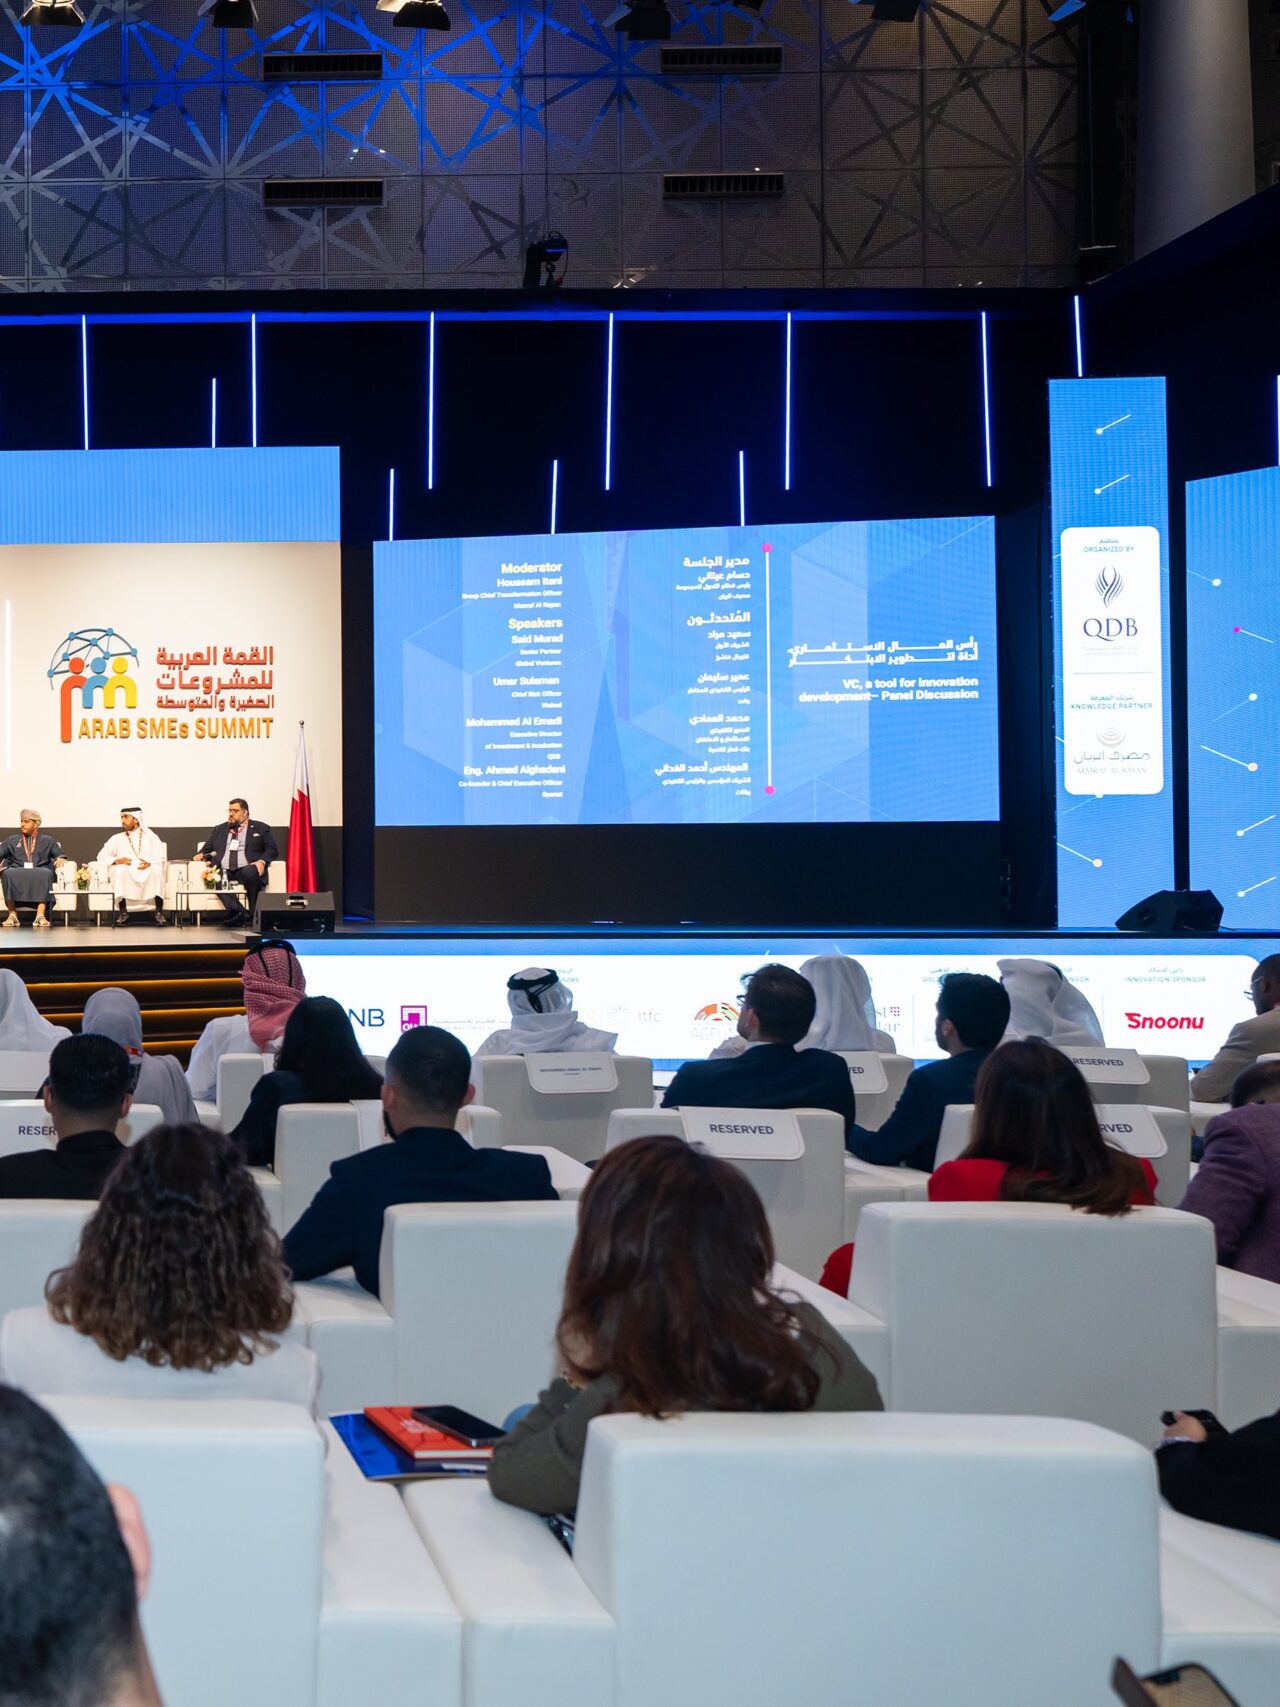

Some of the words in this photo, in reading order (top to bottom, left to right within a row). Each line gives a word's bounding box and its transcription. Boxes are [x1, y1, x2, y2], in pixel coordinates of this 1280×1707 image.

[501, 562, 562, 574] Moderator
[683, 556, 722, 568] الجلسة
[725, 557, 750, 568] مدير
[497, 578, 540, 587] Houssam
[508, 618, 563, 631] Speakers
[1083, 618, 1138, 641] QDB
[512, 635, 532, 644] Said
[534, 634, 563, 643] Murad
[156, 646, 217, 671] العربية
[223, 646, 274, 666] القمة
[156, 669, 273, 694] للمشروعات
[493, 677, 518, 686] Umer
[520, 677, 559, 686] Suleman
[842, 679, 863, 690] VC,
[875, 678, 897, 688] tool
[899, 678, 916, 688] for
[918, 676, 978, 687] innovation
[881, 690, 913, 700] Panel
[916, 689, 978, 700] Discussion
[156, 695, 225, 712] والمتوسطة
[230, 695, 274, 712] الصغيرة
[466, 718, 520, 727] Mohammed
[522, 717, 532, 726] Al
[534, 717, 562, 726] Emadi
[79, 718, 131, 739] ARAB
[137, 718, 189, 739] SMEs
[195, 718, 274, 739] SUMMIT
[464, 766, 483, 776] Eng.
[486, 766, 518, 774] Ahmed
[349, 1009, 385, 1027] NB
[1125, 1013, 1204, 1029] Snoonu
[1072, 1058, 1124, 1066] RESERVED
[18, 1126, 56, 1135] RESER
[709, 1124, 774, 1136] RESERVED
[1099, 1124, 1133, 1132] RVED
